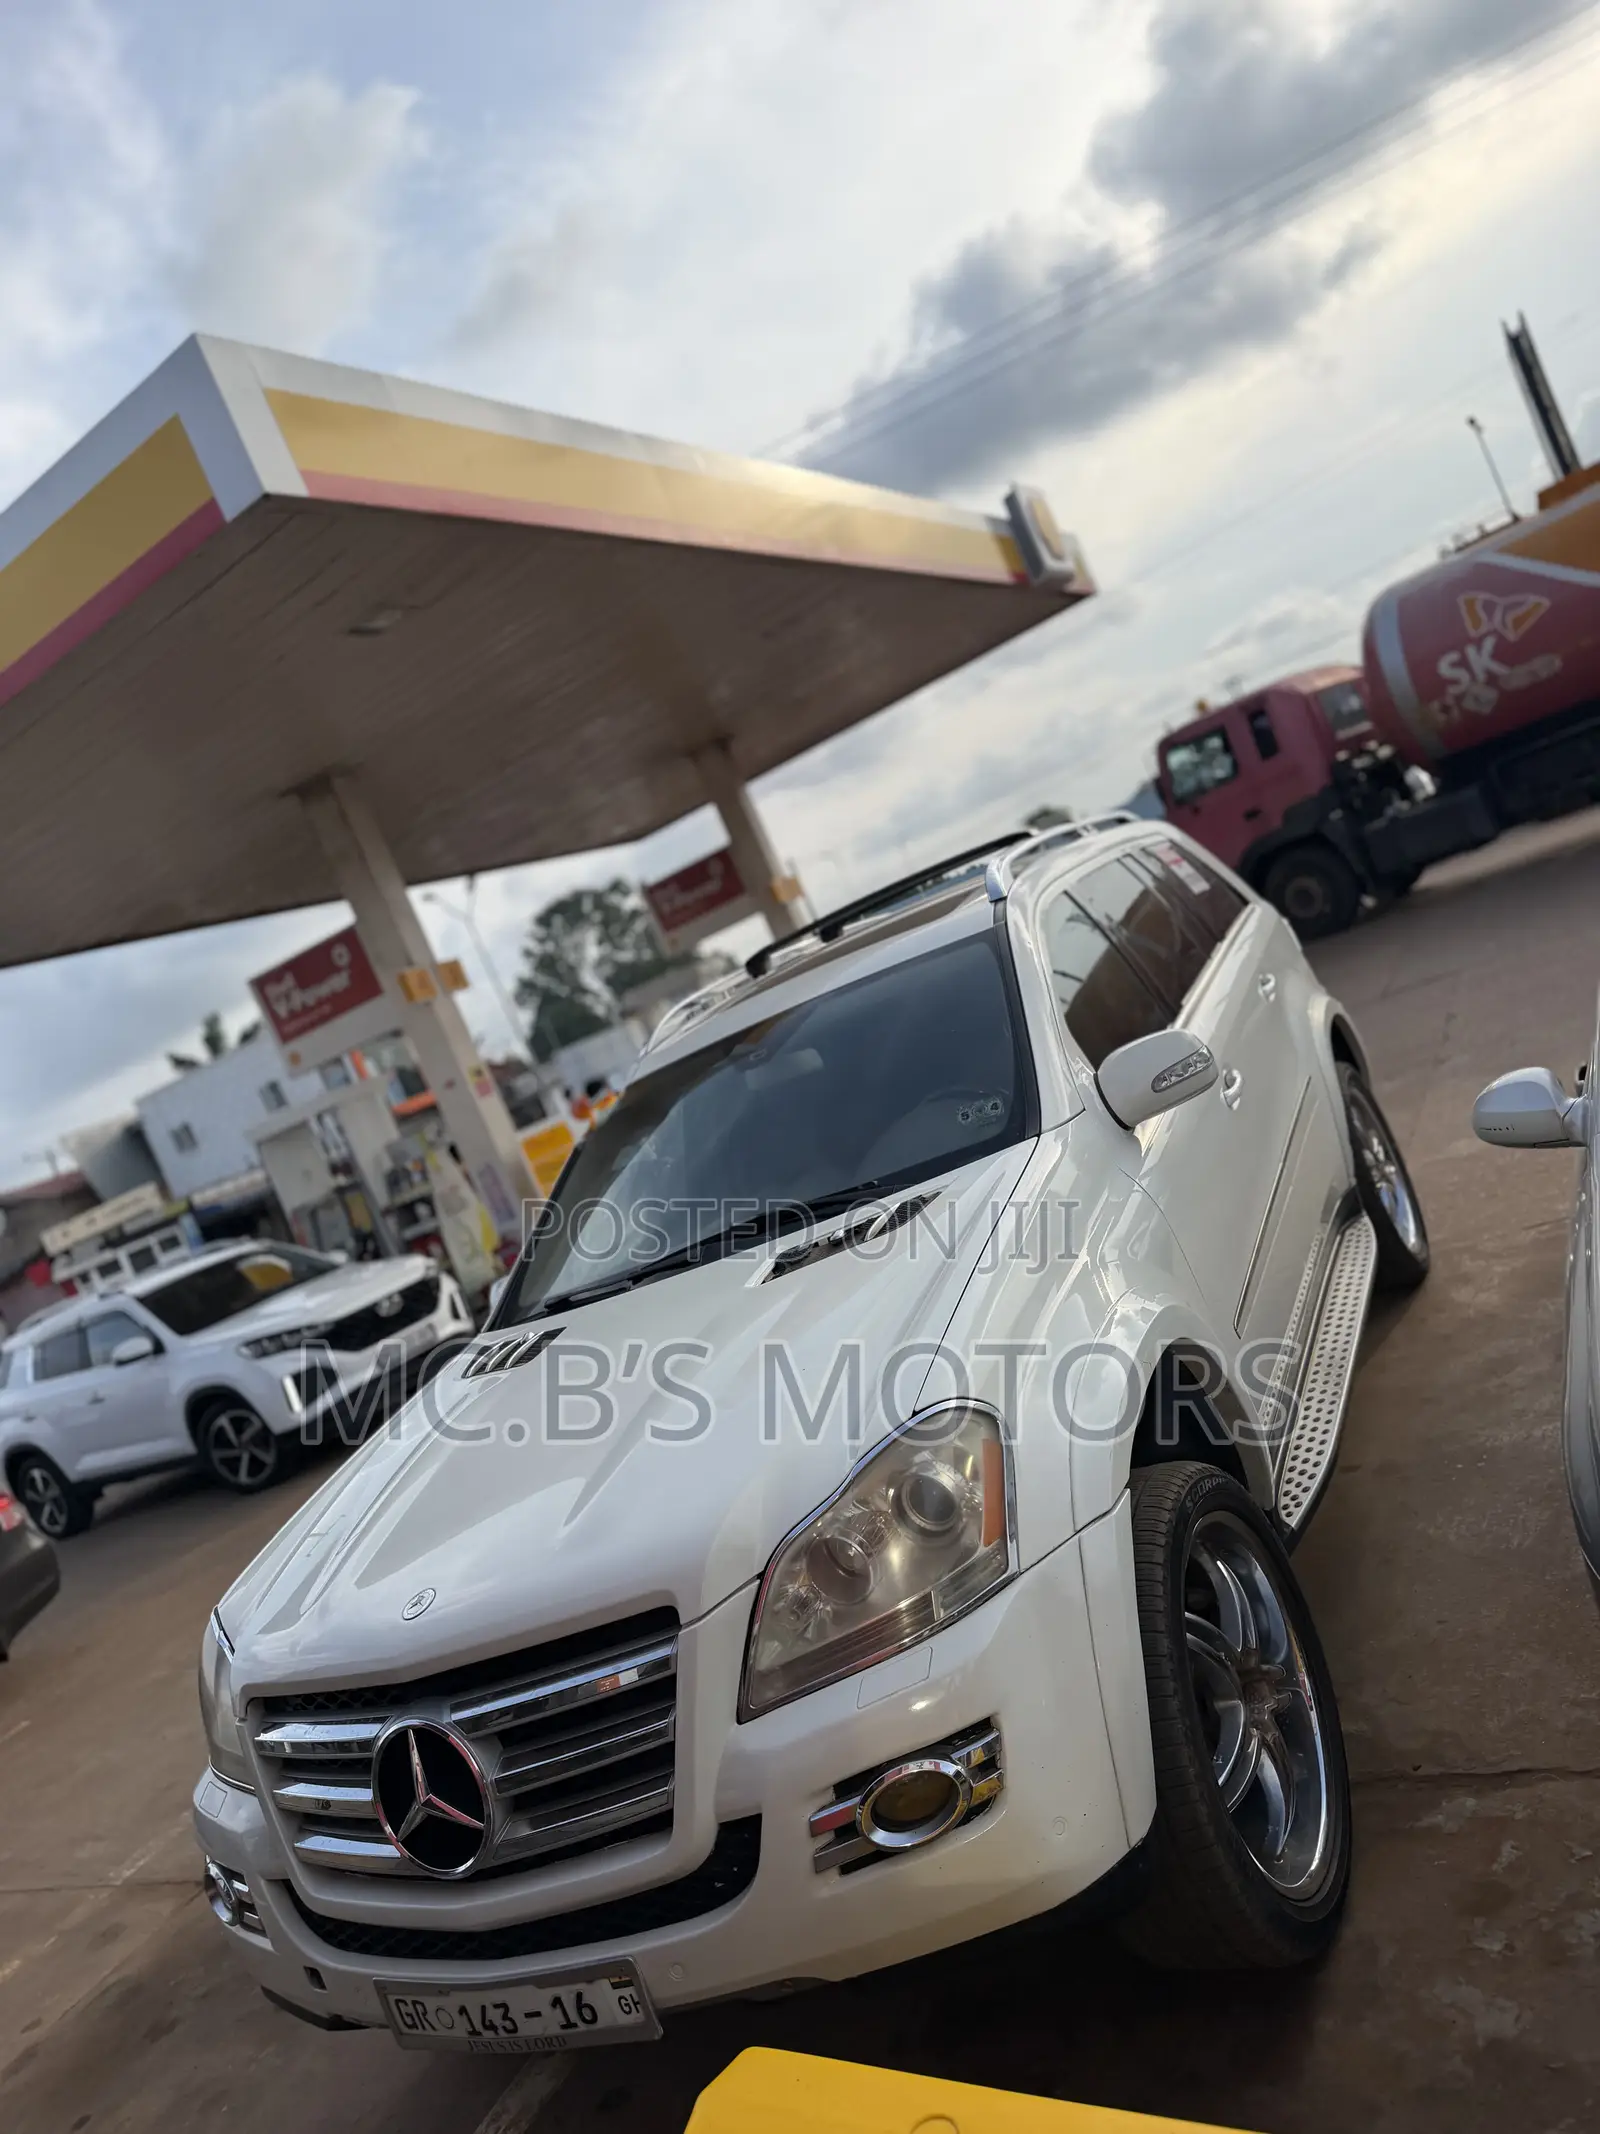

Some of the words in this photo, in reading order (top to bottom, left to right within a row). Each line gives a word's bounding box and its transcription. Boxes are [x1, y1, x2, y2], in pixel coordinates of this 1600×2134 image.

[1437, 634, 1512, 695] SK
[393, 1998, 438, 2031] GR
[525, 2035, 568, 2051] LORD
